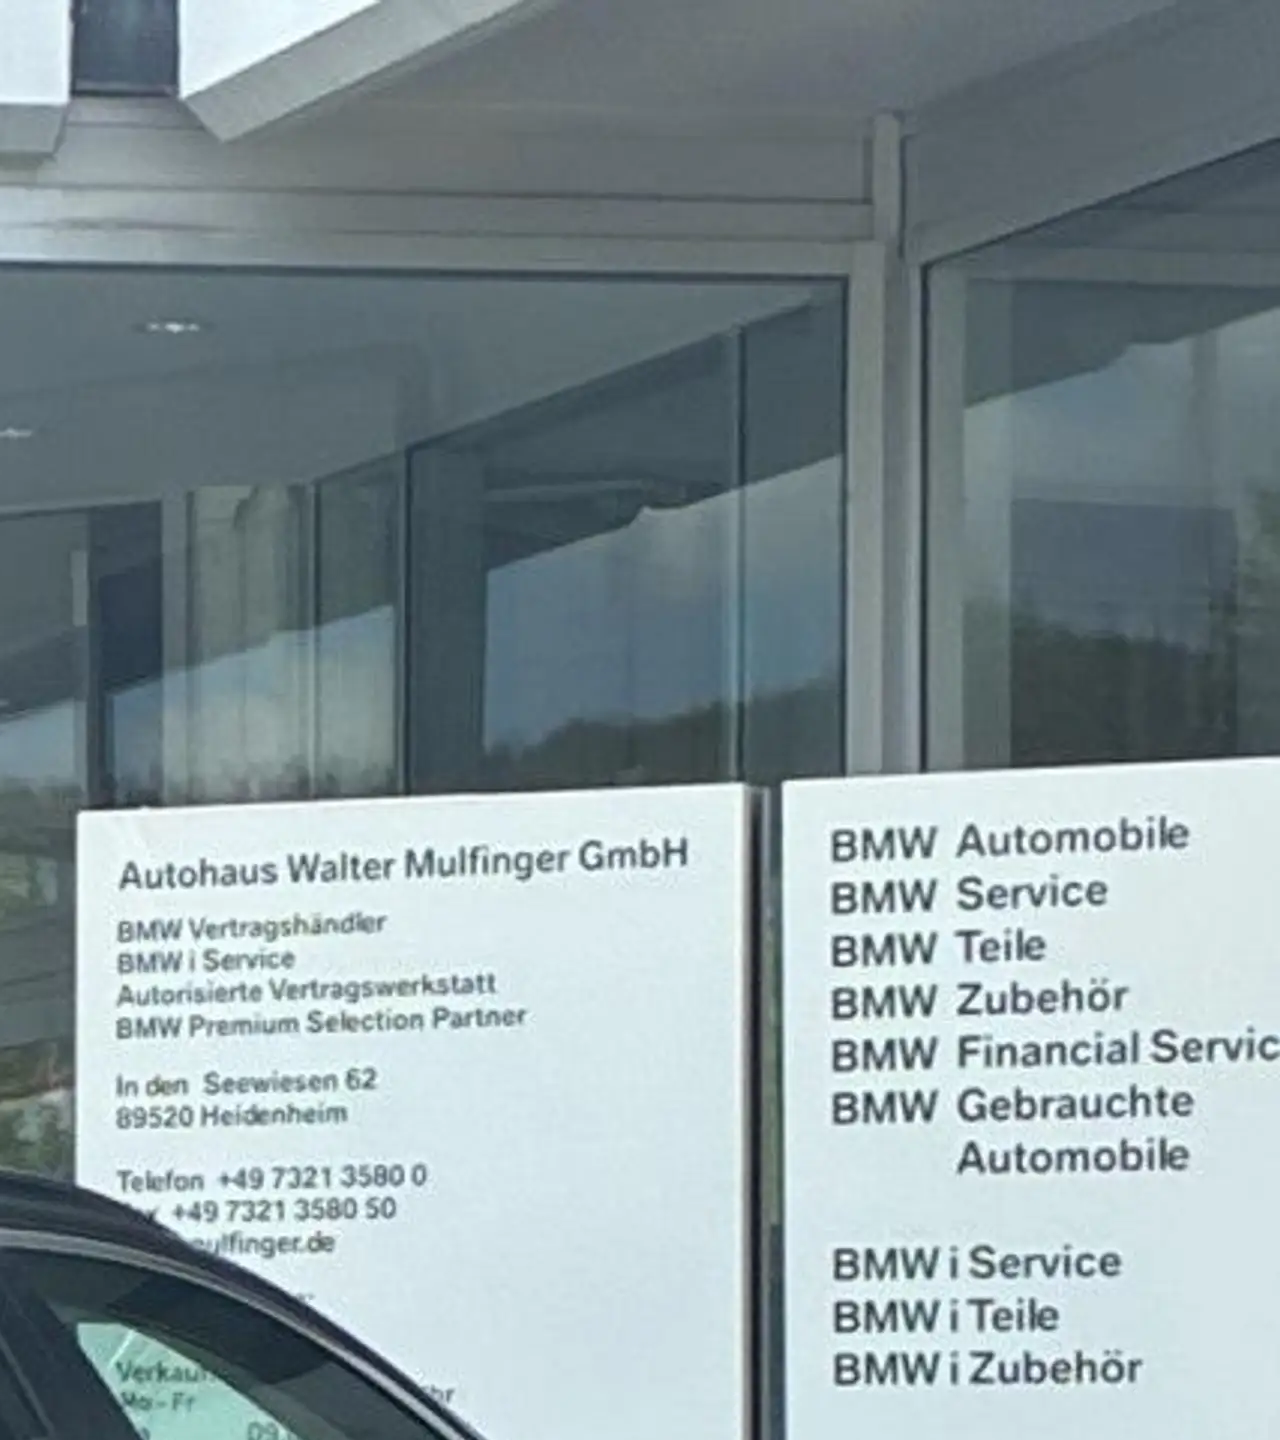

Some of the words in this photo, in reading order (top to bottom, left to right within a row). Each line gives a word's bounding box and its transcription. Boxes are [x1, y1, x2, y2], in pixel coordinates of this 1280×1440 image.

[831, 826, 938, 863] BMW
[955, 815, 1190, 858] Automobile
[118, 857, 279, 891] Autohaus
[287, 852, 396, 883] Walter
[404, 845, 571, 881] Mulfinger
[578, 837, 688, 872] GmbH
[831, 879, 937, 915] BMW
[957, 873, 1108, 912] Service
[117, 918, 183, 944] BMW
[188, 911, 387, 943] Vertragshändler
[117, 951, 183, 975] BMW
[188, 950, 196, 973] i
[202, 948, 296, 972] Service
[831, 931, 938, 968] BMW
[954, 927, 1047, 963] Teile
[116, 982, 263, 1008] Autorisierte
[268, 973, 497, 1005] Vertragswerkstatt
[831, 984, 938, 1021] BMW
[956, 978, 1129, 1016] Zubehör
[115, 1017, 182, 1040] BMW
[188, 1014, 301, 1038] Premium
[306, 1009, 425, 1034] Selection
[432, 1006, 527, 1030] Partner
[832, 1036, 938, 1073] BMW
[958, 1030, 1140, 1069] Financial
[1150, 1027, 1280, 1064] Servic
[115, 1075, 139, 1097] In
[145, 1076, 189, 1097] den
[203, 1070, 339, 1096] Seewiesen
[345, 1067, 377, 1091] 62
[115, 1105, 195, 1130] 89520
[200, 1103, 349, 1127] Heidenheim
[832, 1089, 939, 1126] BMW
[957, 1083, 1195, 1123] Gebrauchte
[956, 1137, 1190, 1175] Automobile
[116, 1169, 205, 1193] Telefon
[219, 1167, 265, 1191] +49
[271, 1165, 331, 1190] 7321
[340, 1164, 405, 1189] 3580
[411, 1163, 428, 1187] 0
[173, 1200, 219, 1224] +49
[225, 1199, 285, 1223] 7321
[295, 1197, 358, 1222] 3580
[365, 1196, 397, 1220] 50
[833, 1247, 940, 1281] BMW
[949, 1246, 958, 1280] i
[969, 1244, 1122, 1280] Service
[833, 1299, 941, 1334] BMW
[949, 1298, 959, 1333] i
[966, 1297, 1060, 1333] Teile
[834, 1352, 941, 1387] BMW
[950, 1351, 959, 1385] i
[969, 1350, 1143, 1385] Zubehör
